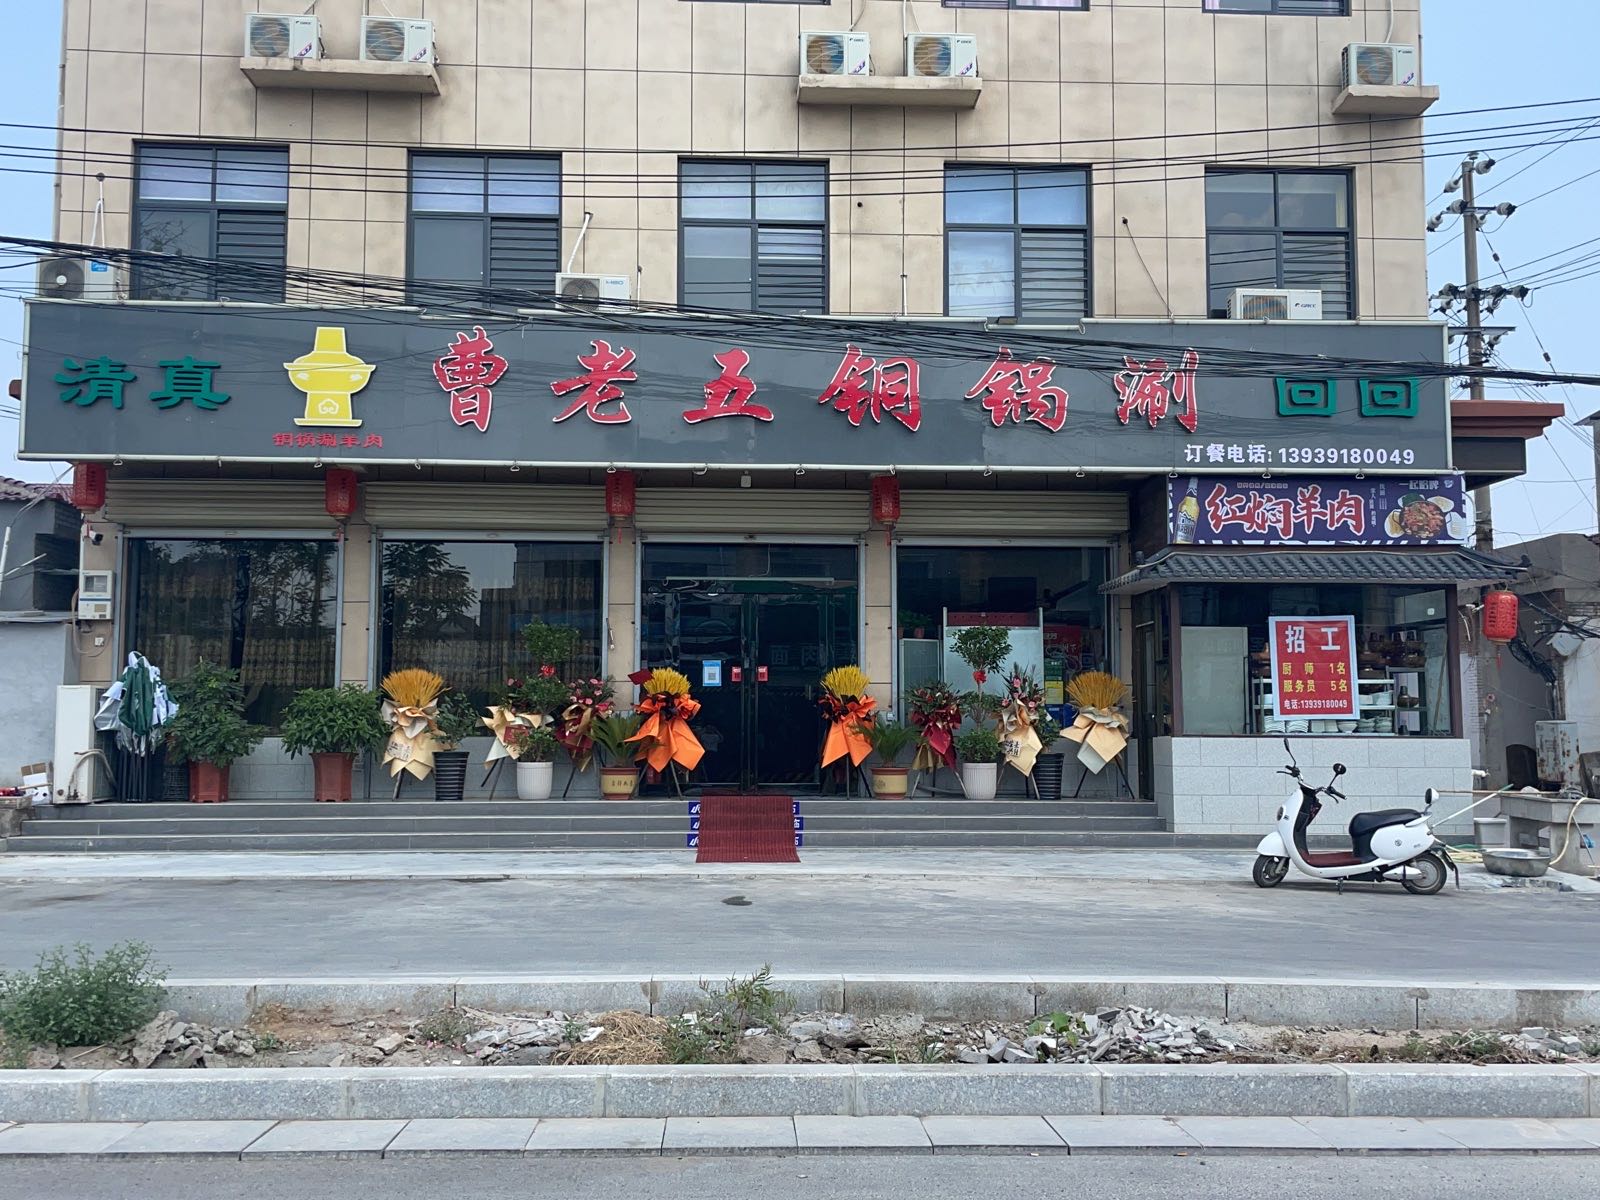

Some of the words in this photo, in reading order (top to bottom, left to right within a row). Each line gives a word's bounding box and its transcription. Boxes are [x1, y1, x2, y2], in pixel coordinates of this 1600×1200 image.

[53, 355, 233, 411] 清真
[432, 325, 1201, 434] 曹老五铜锅涮
[272, 432, 384, 448] 铜锅涮羊肉
[1205, 482, 1365, 539] 红焖羊肉
[1284, 624, 1341, 654] 招工
[1283, 680, 1316, 693] 服务员
